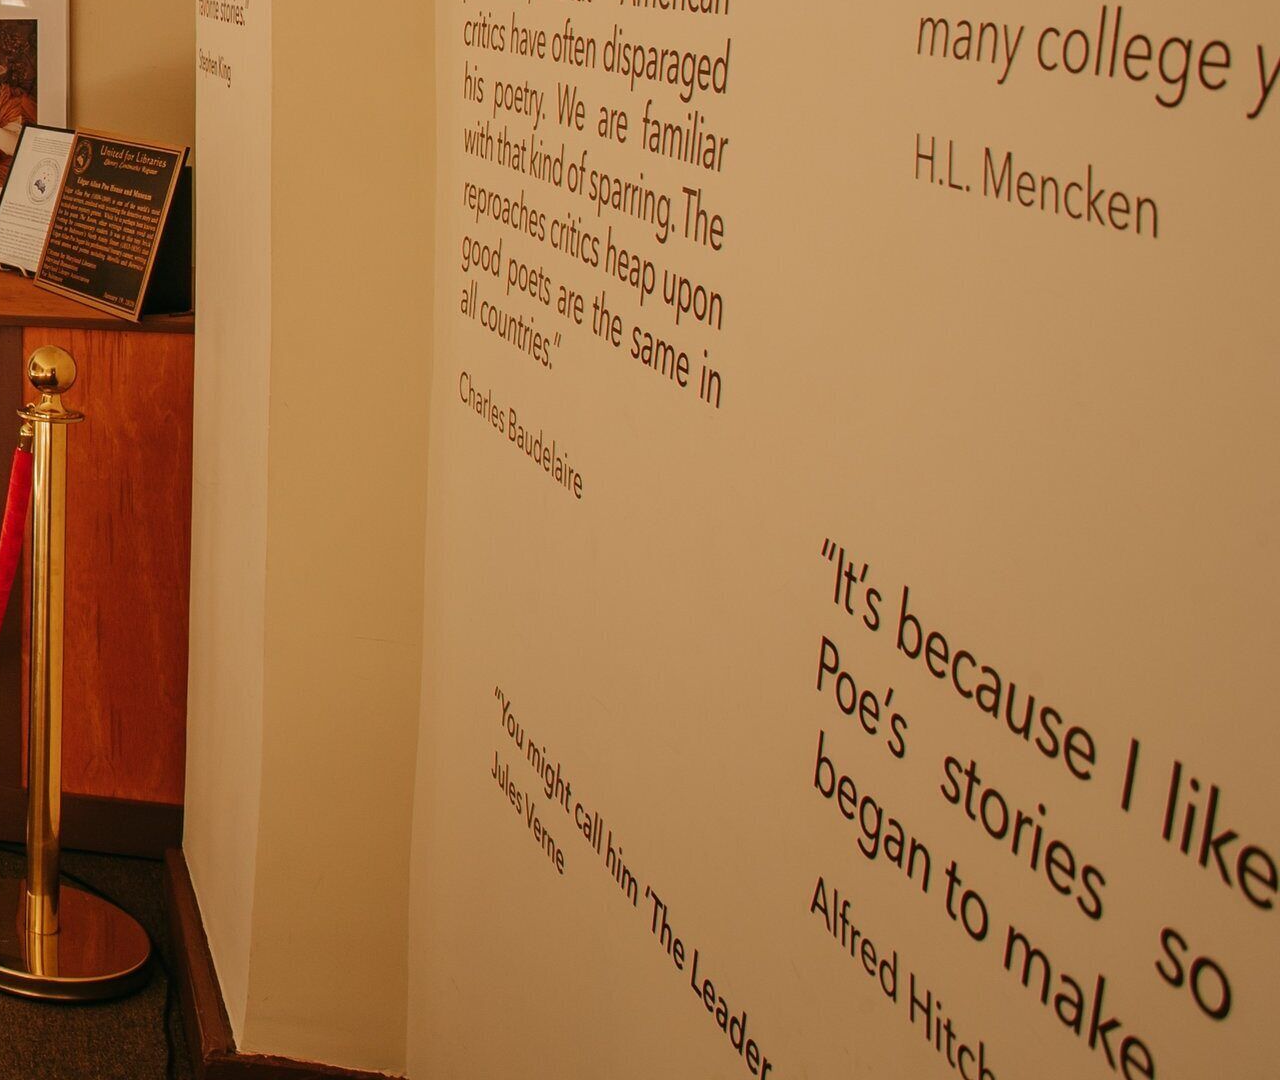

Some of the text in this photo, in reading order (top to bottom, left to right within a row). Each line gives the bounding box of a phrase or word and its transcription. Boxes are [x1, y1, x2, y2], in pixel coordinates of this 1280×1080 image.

[199, 47, 232, 89] Stephen King
[464, 11, 731, 103] critics have often disparaged
[464, 61, 729, 172] his poetry. We are familiar
[917, 17, 1024, 85] many
[1038, 5, 1231, 108] college
[100, 144, 123, 160] United
[124, 152, 136, 163] for
[136, 150, 168, 169] Libraries
[464, 121, 724, 251] with that kind of sparring. The
[916, 134, 1158, 238] H.L. Mencken
[464, 182, 722, 330] reproaches critics heap upon
[461, 280, 561, 370] all countries."
[462, 236, 721, 408] good poets are the same in
[460, 371, 582, 499] Charles Baudelaire
[821, 538, 1279, 911] "It's because I like
[491, 751, 564, 875] Jules Verne
[817, 636, 1232, 1022] Poe's stories so
[495, 686, 772, 1080] "You might call him 'The Leader
[811, 876, 897, 1003] Alfred
[814, 730, 1155, 1080] began to make
